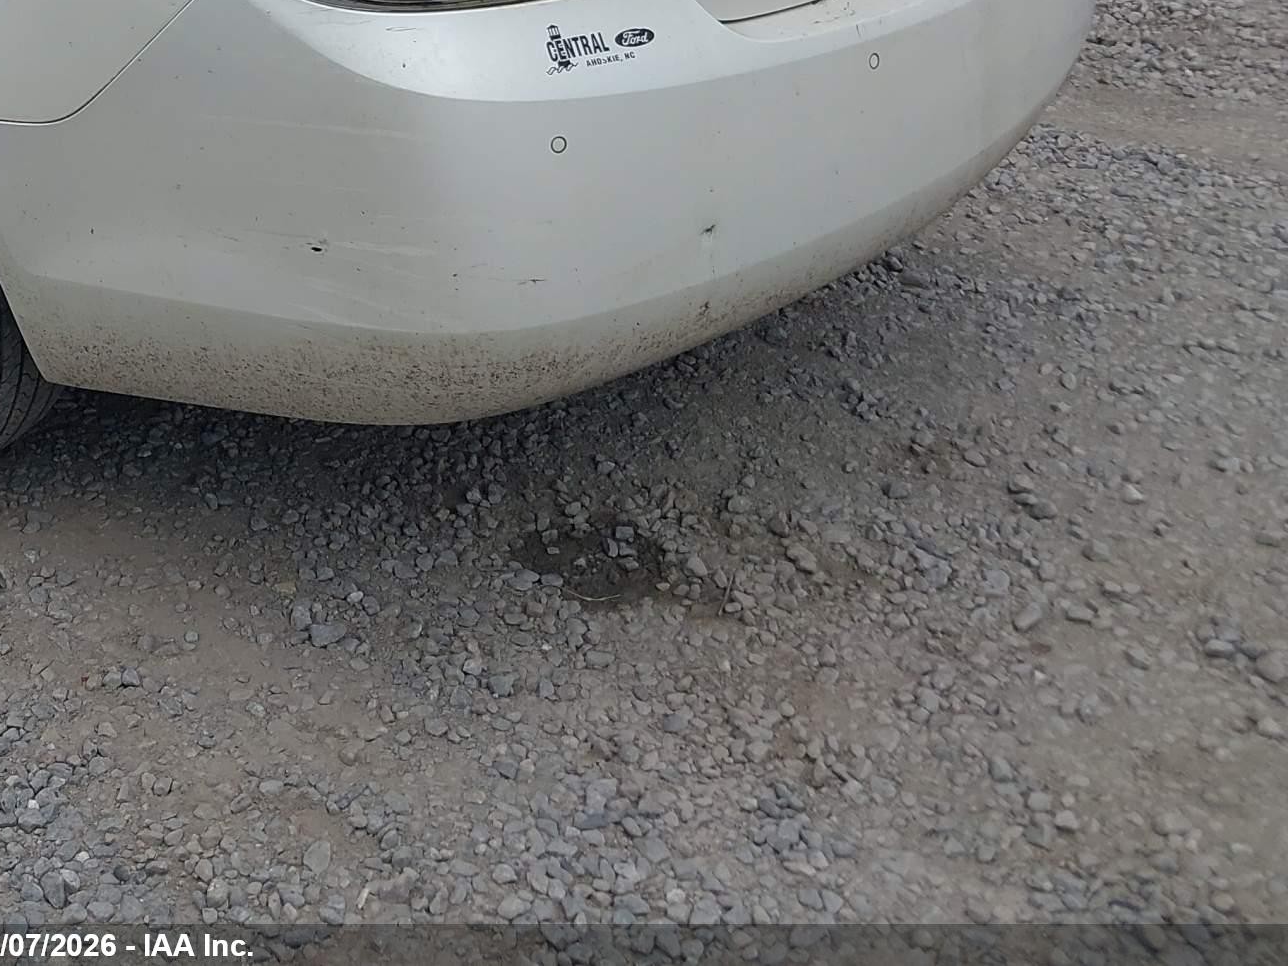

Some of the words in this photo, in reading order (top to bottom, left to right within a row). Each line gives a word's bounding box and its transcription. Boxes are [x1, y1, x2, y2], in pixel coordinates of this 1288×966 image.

[546, 32, 610, 62] CENTRAL
[621, 30, 649, 46] Ford
[624, 51, 636, 60] NC
